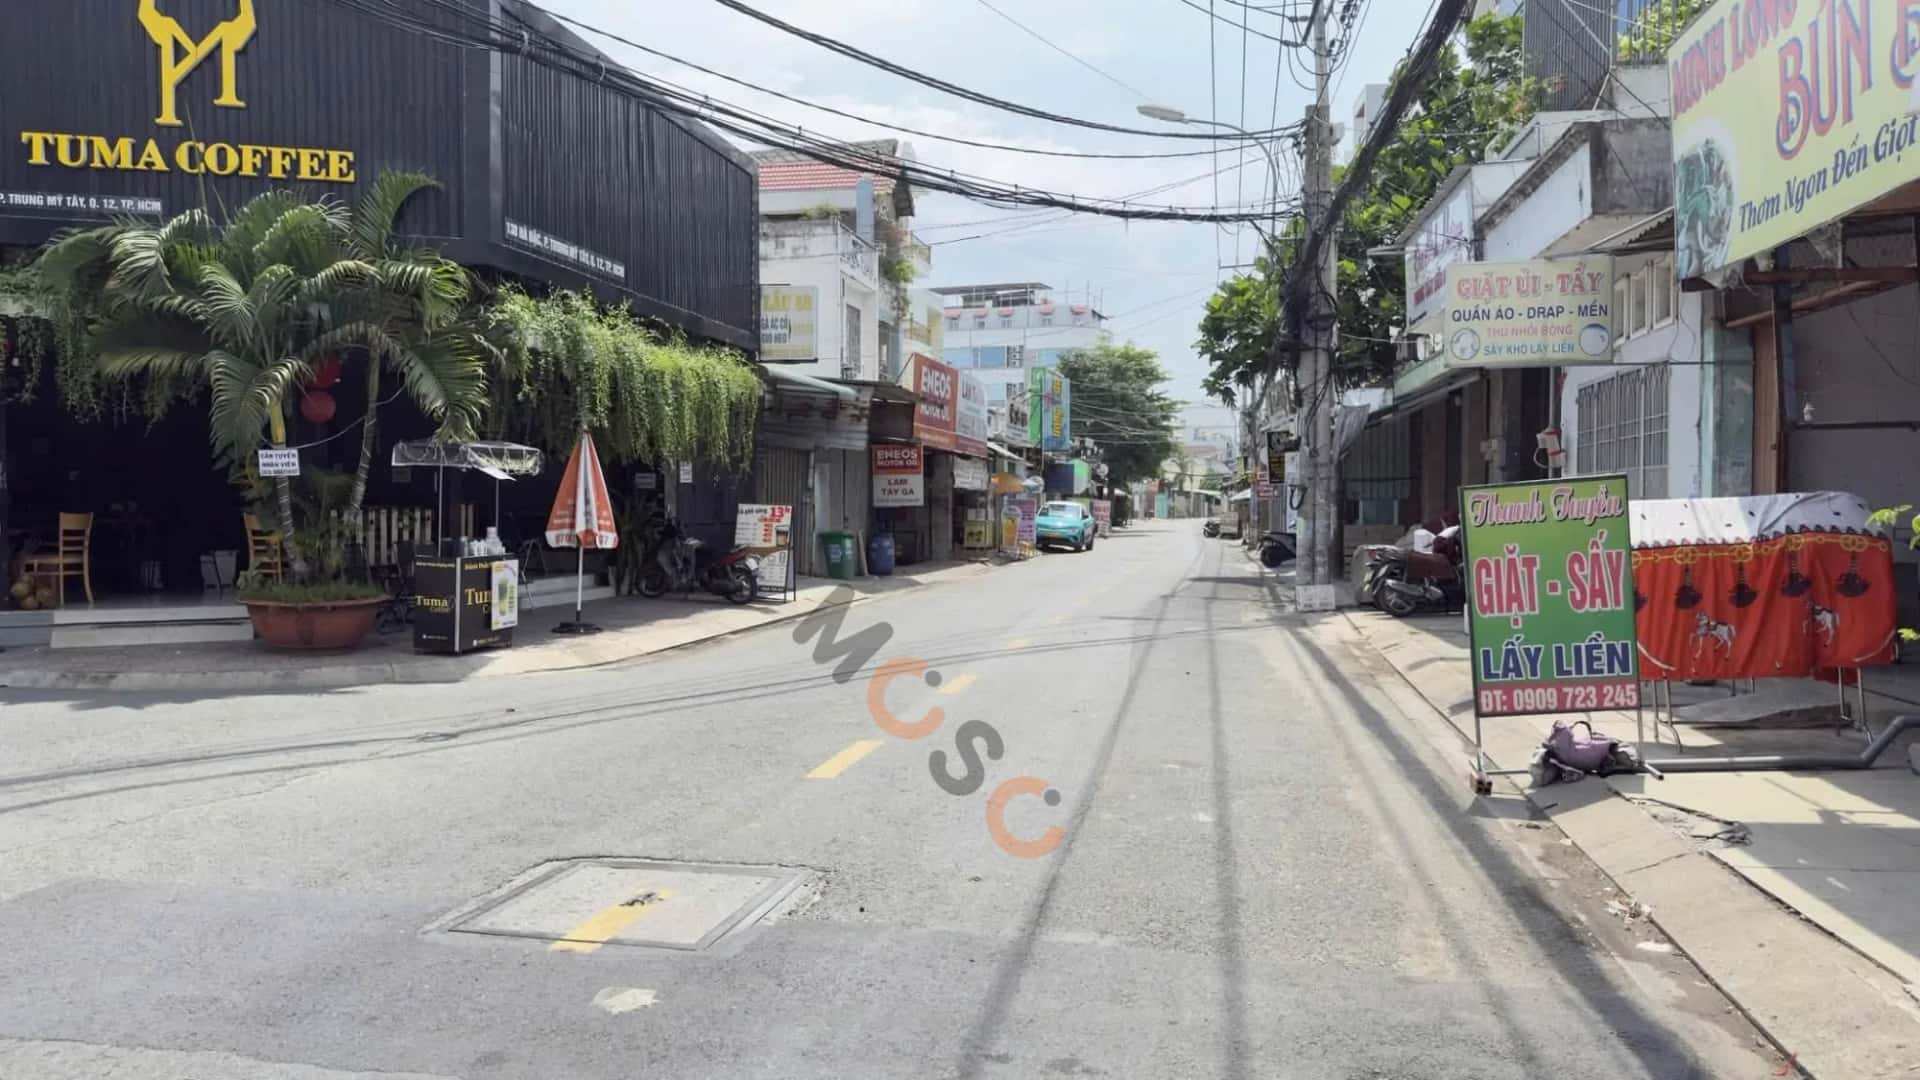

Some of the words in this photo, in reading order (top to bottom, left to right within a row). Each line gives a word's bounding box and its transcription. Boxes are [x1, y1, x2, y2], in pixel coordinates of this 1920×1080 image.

[21, 131, 170, 172] TUMA
[175, 140, 356, 184] COFFEE
[1739, 193, 1780, 232] Thơm
[1784, 176, 1827, 214] Ngon
[1832, 133, 1868, 186] Đến
[8, 193, 44, 206] TRUNG
[138, 200, 161, 211] HCM
[1527, 305, 1565, 320] DRAP
[921, 367, 951, 400] ENEOS
[877, 448, 918, 459] ENEOS
[1470, 489, 1546, 527] Thanh
[1474, 543, 1540, 628] GIẶT
[1567, 529, 1625, 612] SẤY
[1481, 634, 1544, 681] LẤY
[1552, 632, 1632, 679] LIỀN
[1513, 687, 1558, 711] 0909
[1563, 685, 1598, 709] 723
[1603, 683, 1637, 708] 245
